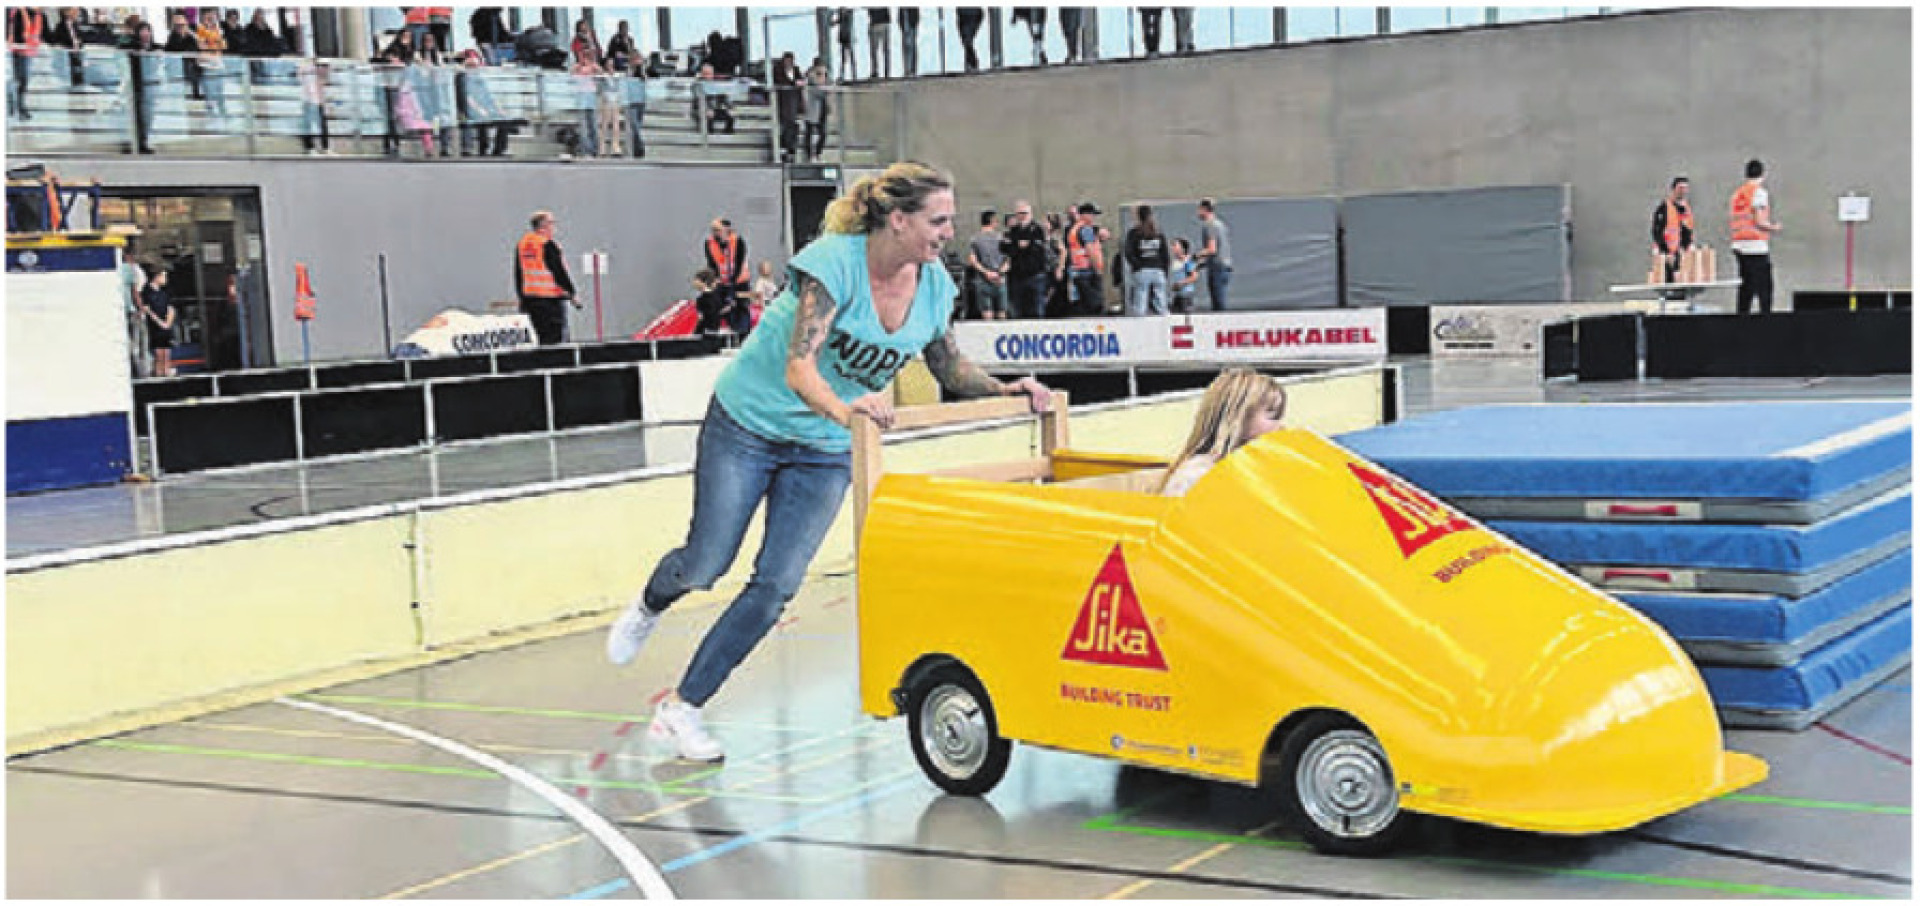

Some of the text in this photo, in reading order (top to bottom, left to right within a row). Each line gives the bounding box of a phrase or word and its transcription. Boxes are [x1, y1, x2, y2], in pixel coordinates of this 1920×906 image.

[995, 324, 1120, 360] CONCORDIA
[1216, 327, 1377, 347] HELUKABEL
[1074, 583, 1149, 657] Sika
[1060, 684, 1171, 712] BUILDING TRUST
